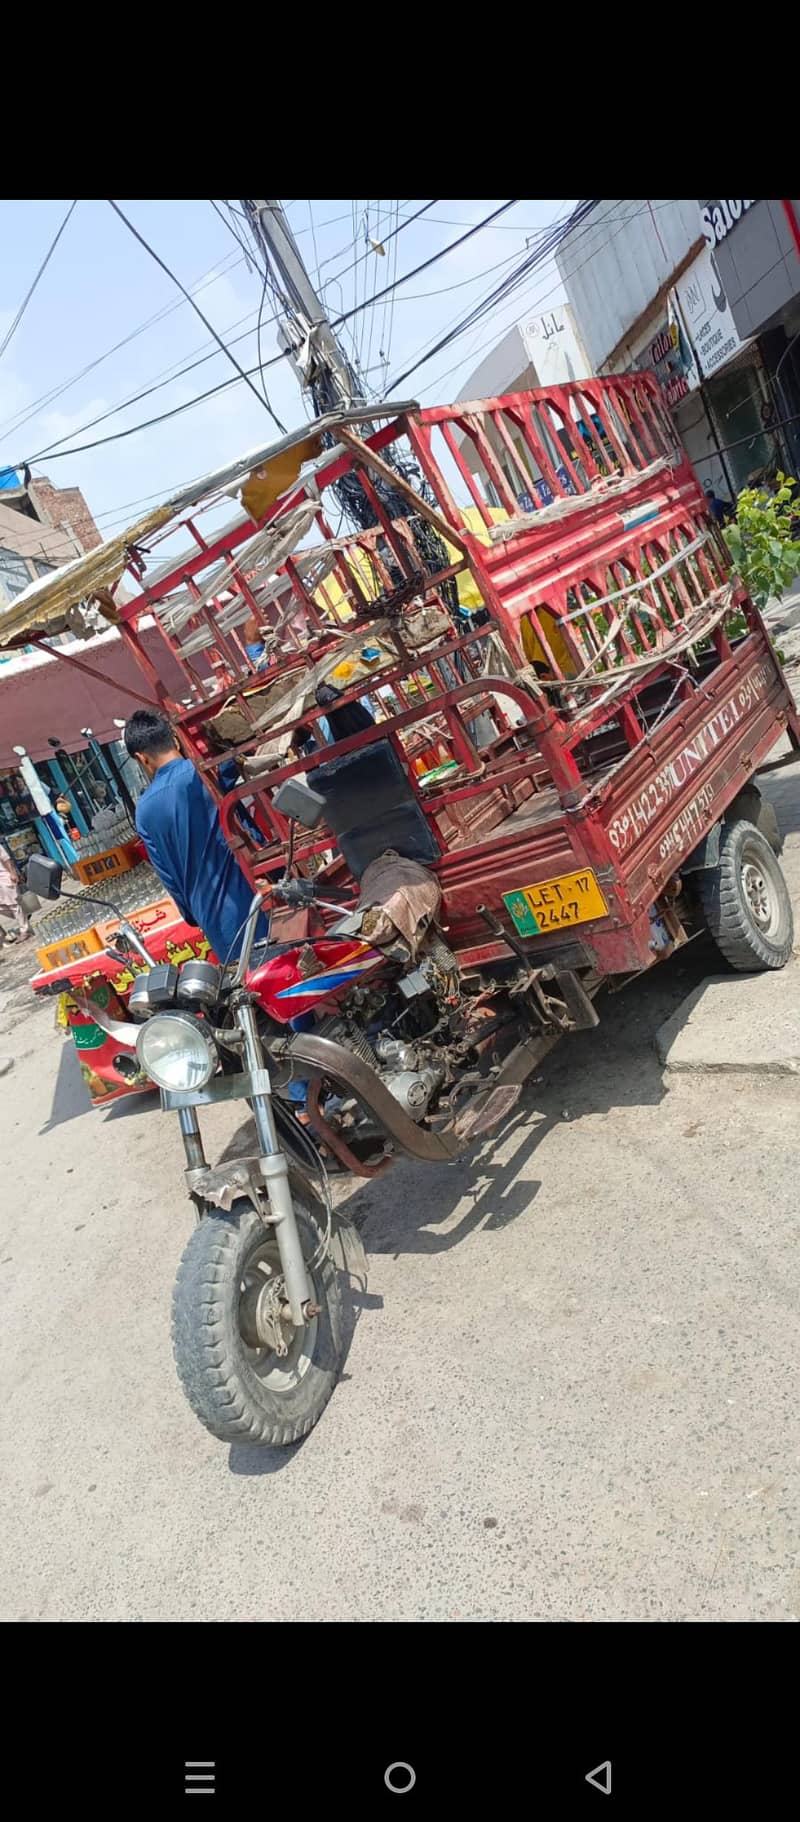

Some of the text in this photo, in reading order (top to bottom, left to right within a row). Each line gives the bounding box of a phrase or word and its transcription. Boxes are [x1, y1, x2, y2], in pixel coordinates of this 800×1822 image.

[701, 200, 755, 250] Salo
[528, 884, 564, 908] LET
[575, 877, 590, 893] 17
[536, 901, 580, 928] 2447
